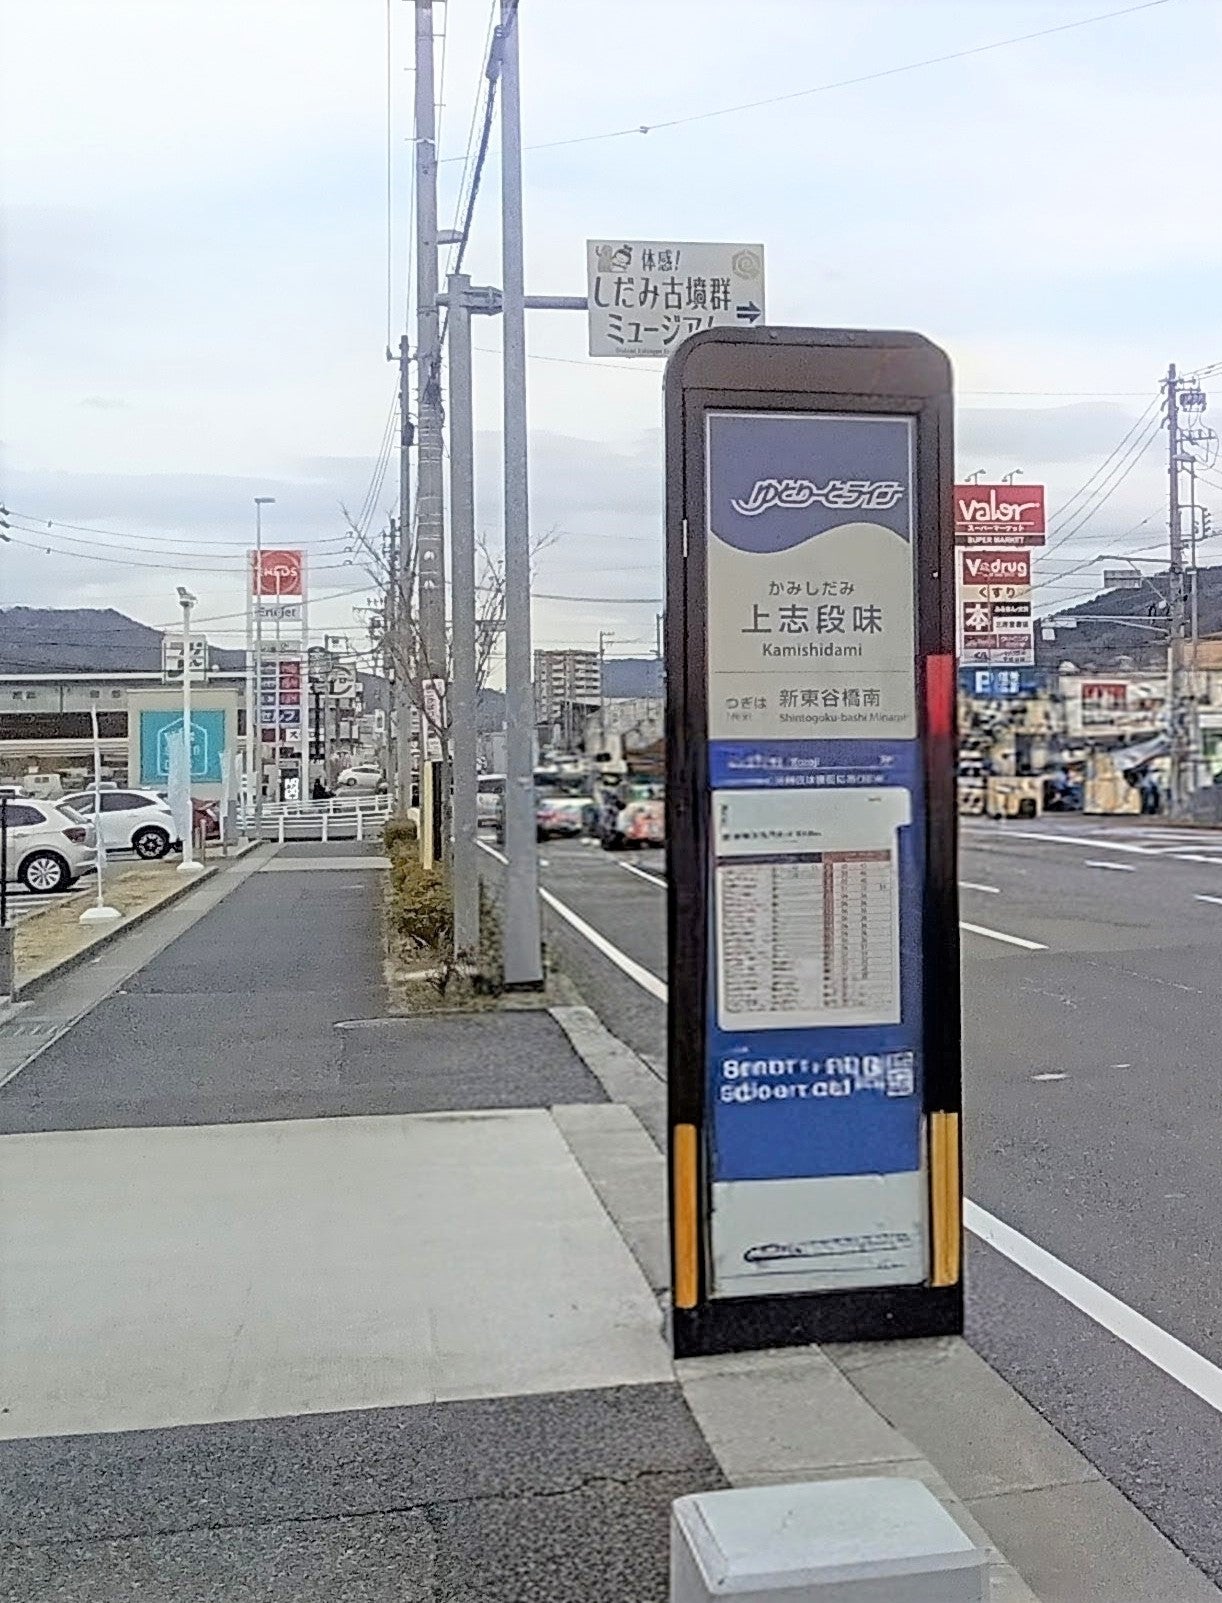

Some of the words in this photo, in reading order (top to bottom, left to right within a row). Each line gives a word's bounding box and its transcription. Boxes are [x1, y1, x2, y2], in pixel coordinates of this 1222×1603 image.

[594, 275, 731, 311] しだみ古墳群
[958, 489, 1041, 521] Valor
[967, 536, 993, 544] SUPER
[994, 536, 1025, 544] MARKET
[768, 580, 855, 597] かみしだみ
[979, 586, 1016, 599] くすり
[741, 604, 883, 635] 上志段味
[965, 603, 989, 631] 本
[762, 643, 863, 657] Kamishidami
[725, 696, 767, 710] つぎは
[779, 688, 881, 708] 新東谷橋南
